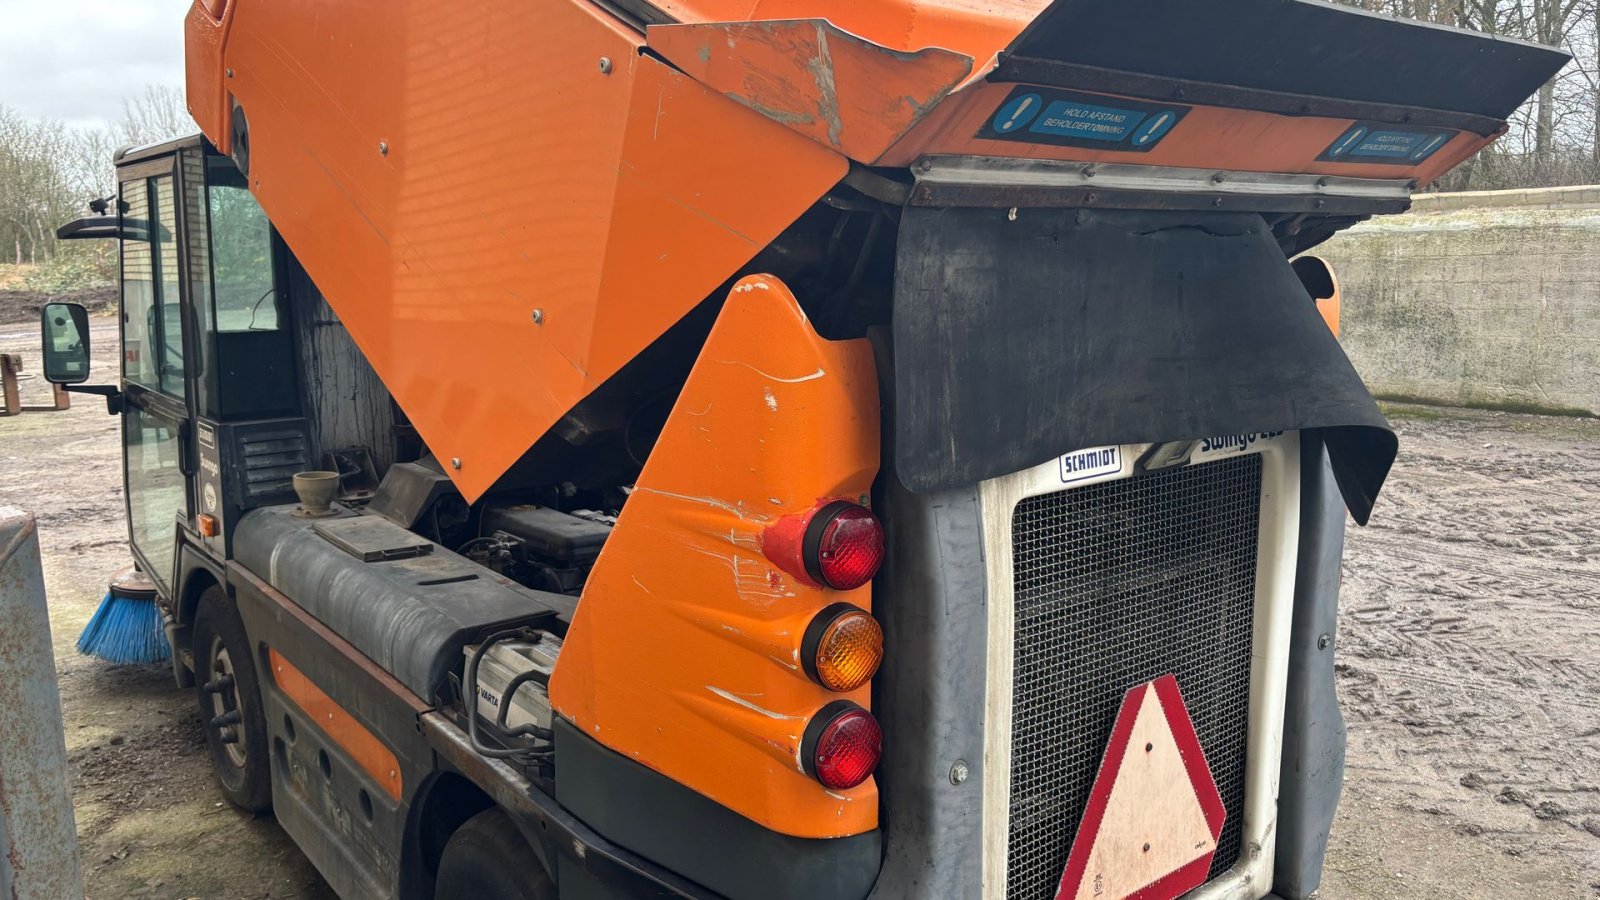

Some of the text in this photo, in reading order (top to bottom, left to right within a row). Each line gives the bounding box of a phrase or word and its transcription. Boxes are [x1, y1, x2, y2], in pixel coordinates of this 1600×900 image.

[1063, 107, 1126, 122] HOLD AFSTAND
[1043, 118, 1125, 134] BEHOLDERTØMNING
[1065, 448, 1116, 473] SCHMIDT
[480, 687, 499, 707] VARTA
